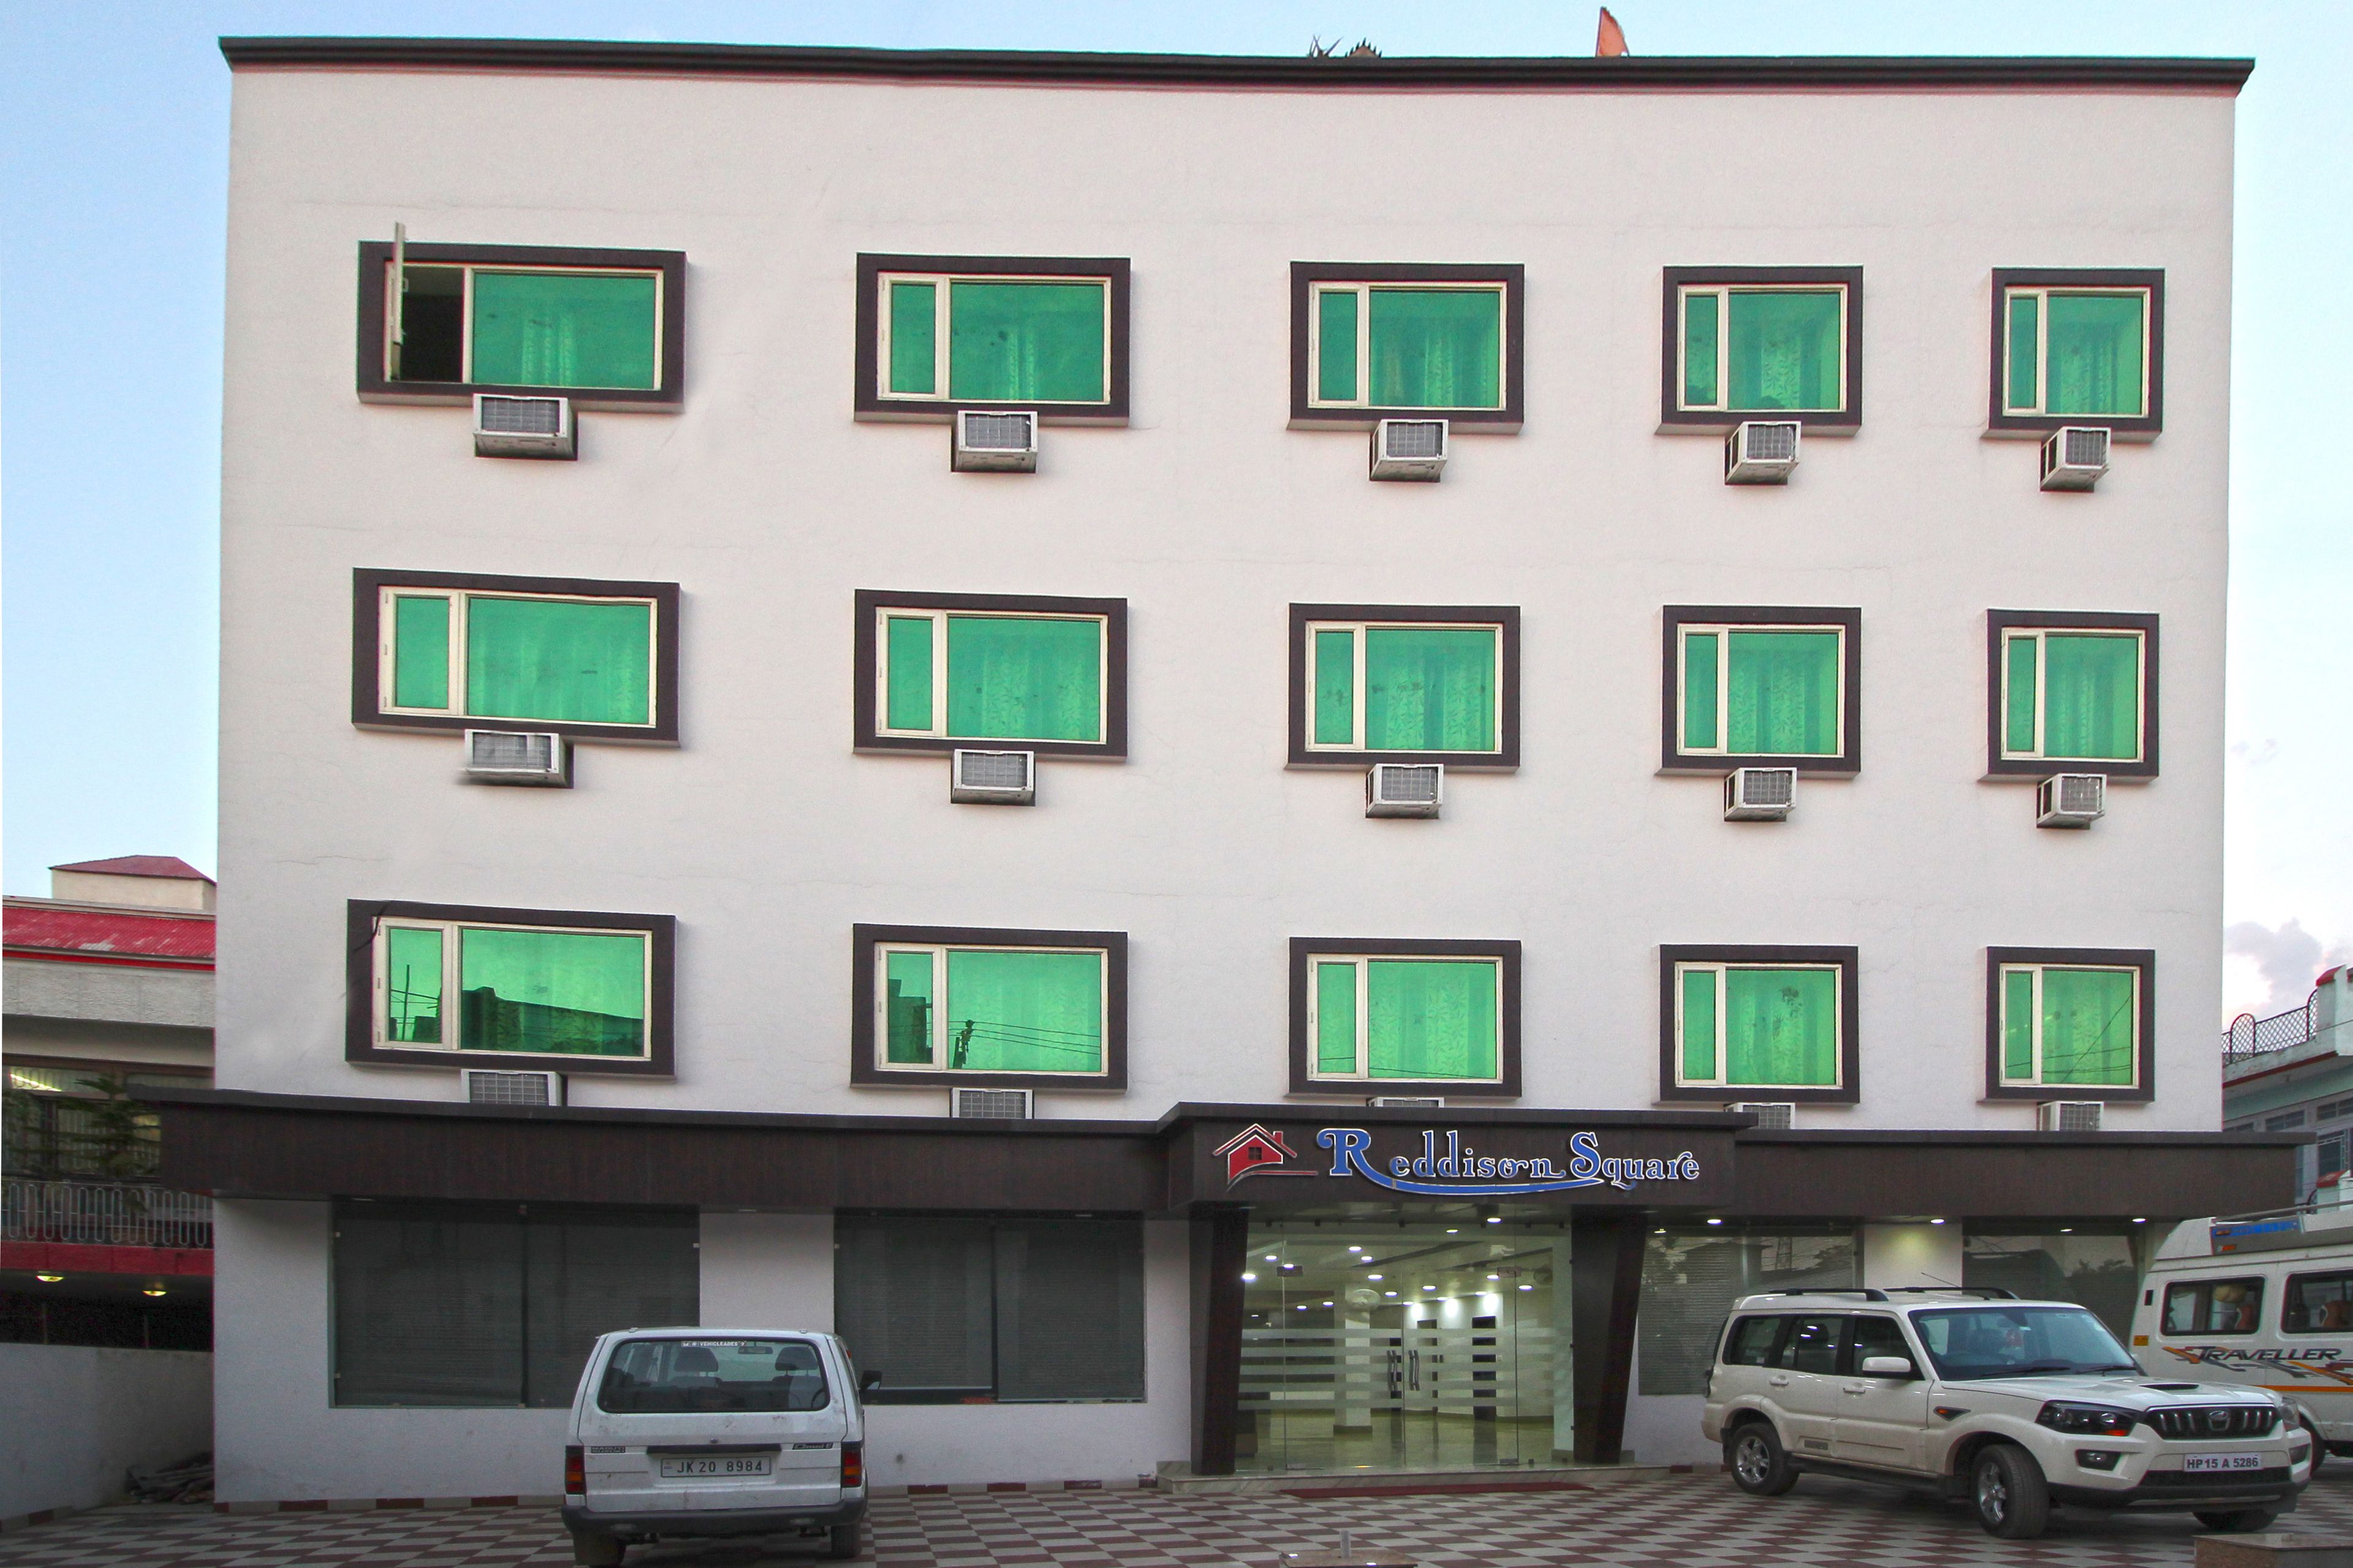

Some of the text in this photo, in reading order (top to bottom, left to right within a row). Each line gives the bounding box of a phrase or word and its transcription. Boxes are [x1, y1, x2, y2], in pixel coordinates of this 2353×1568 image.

[1317, 1128, 1700, 1194] Reddison Square
[2188, 1346, 2342, 1360] TRAVELLER
[727, 1461, 762, 1472] 8984
[2233, 1457, 2258, 1468] 5286
